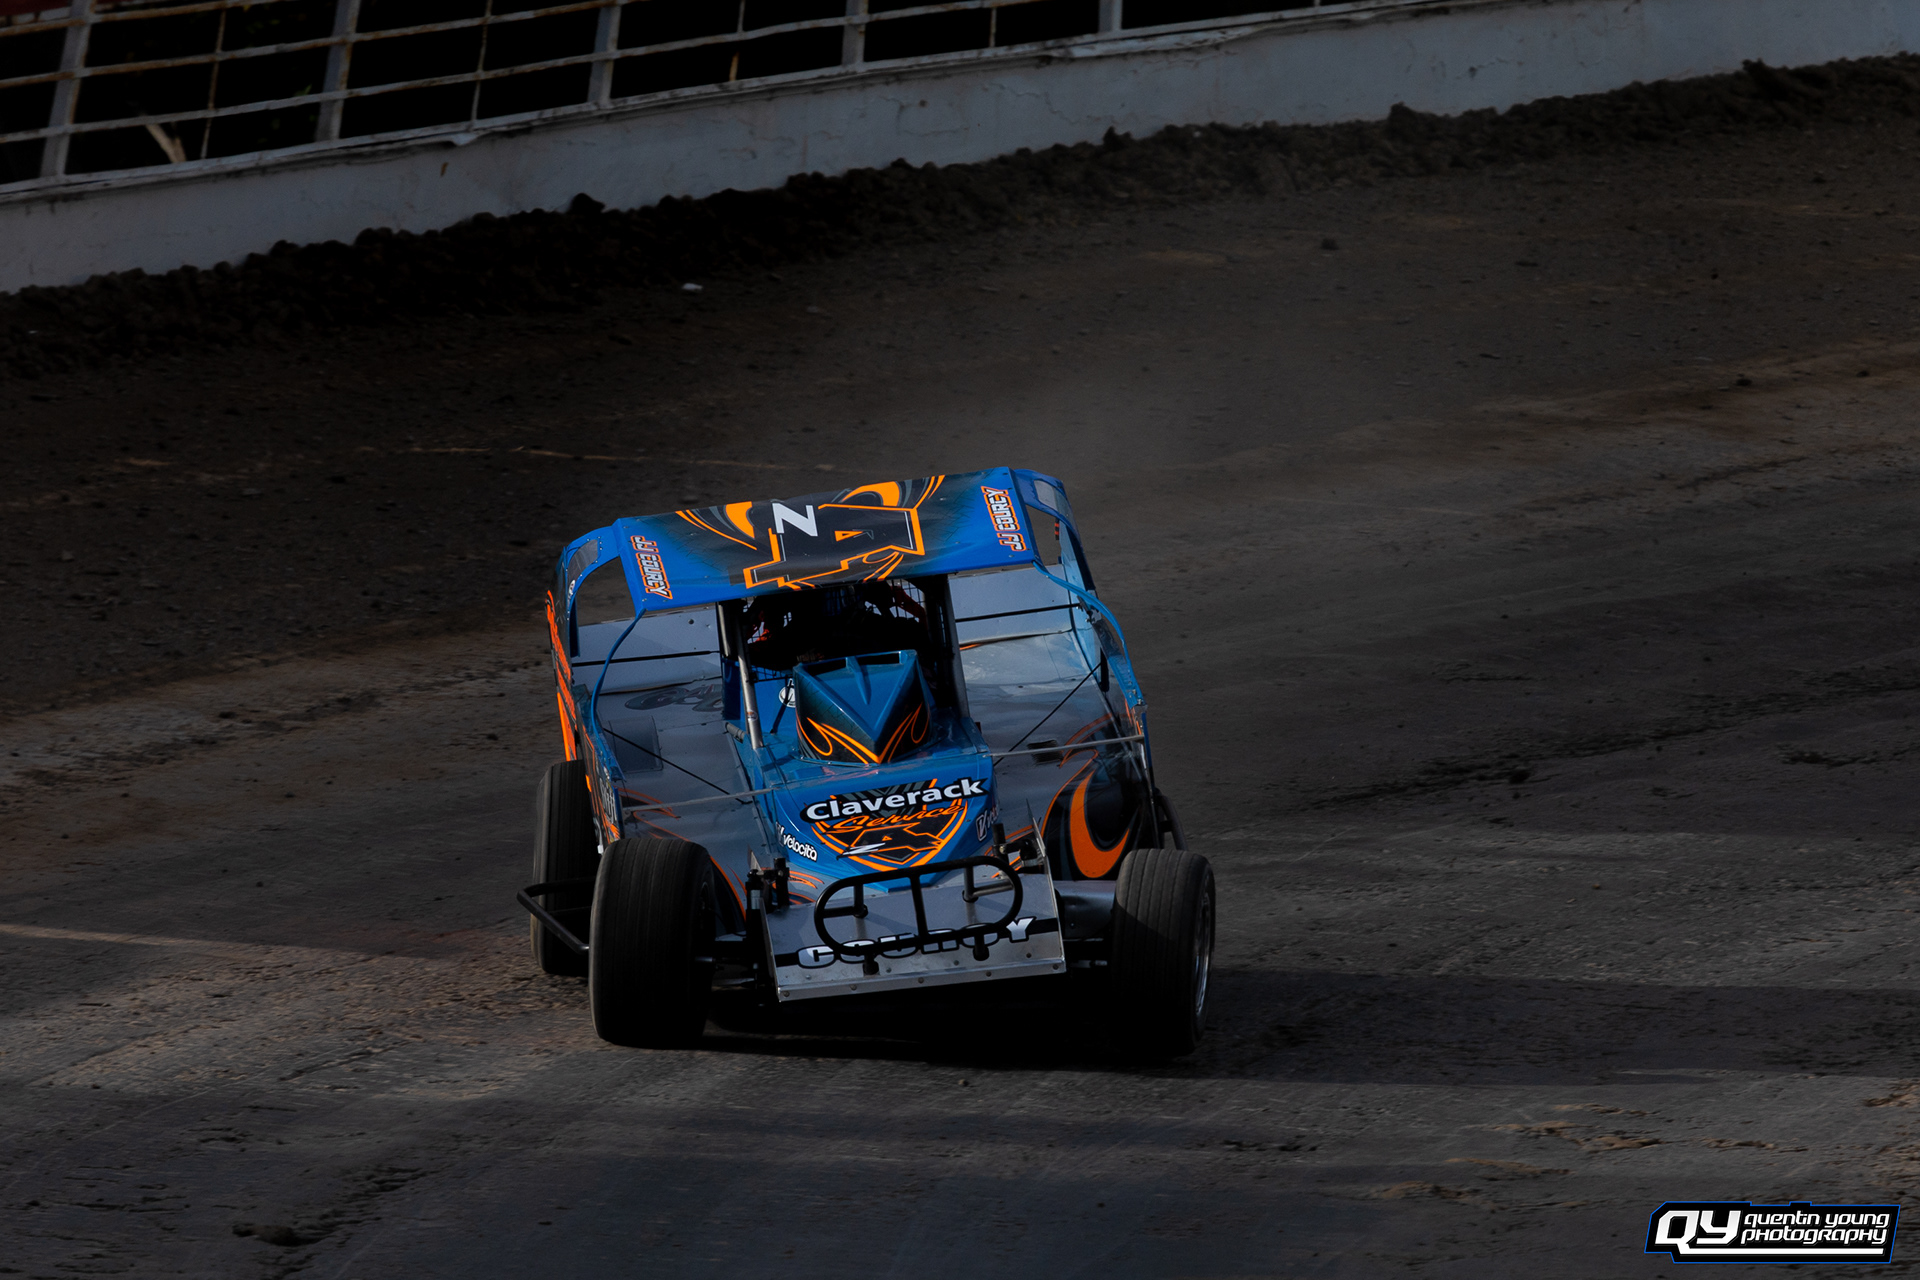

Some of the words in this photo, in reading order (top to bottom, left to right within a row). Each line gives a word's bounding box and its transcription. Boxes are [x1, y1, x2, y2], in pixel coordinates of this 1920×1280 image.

[981, 486, 1021, 535] COURCY
[631, 535, 659, 555] JJ
[998, 530, 1026, 552] JJ
[636, 552, 673, 600] COURCY
[806, 778, 984, 820] Claverack
[823, 805, 964, 833] Service
